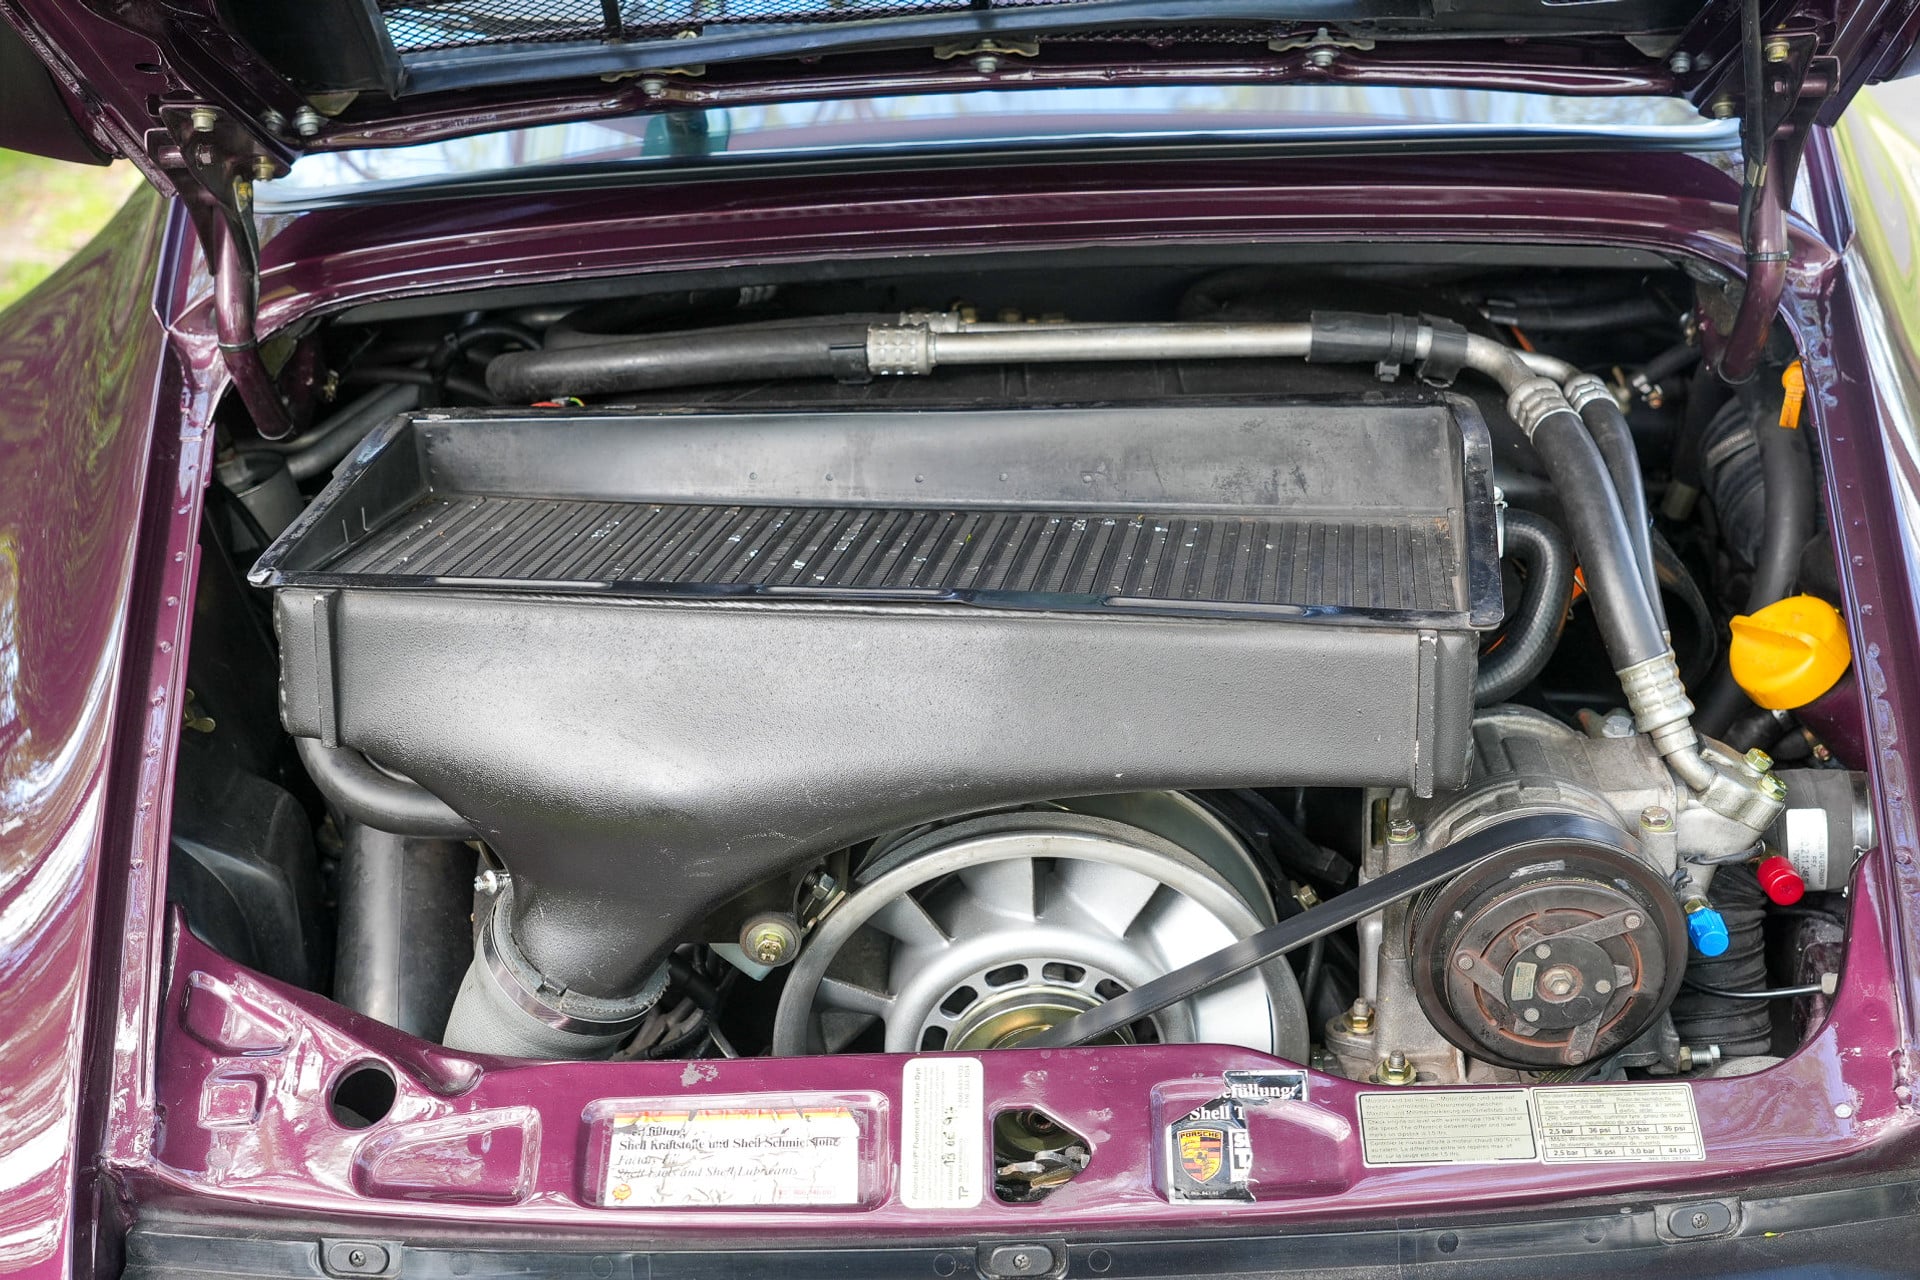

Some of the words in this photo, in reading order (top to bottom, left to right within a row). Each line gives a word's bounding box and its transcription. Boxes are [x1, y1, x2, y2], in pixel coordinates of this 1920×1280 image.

[1189, 1105, 1230, 1120] Shell
[1599, 1126, 1611, 1135] psi
[1674, 1125, 1686, 1133] psi
[1180, 1131, 1220, 1139] PORSCHE
[619, 1139, 647, 1151] Shell
[708, 1138, 729, 1149] und
[1605, 1148, 1617, 1156] psi
[1643, 1147, 1655, 1155] bar
[1679, 1147, 1692, 1155] psi
